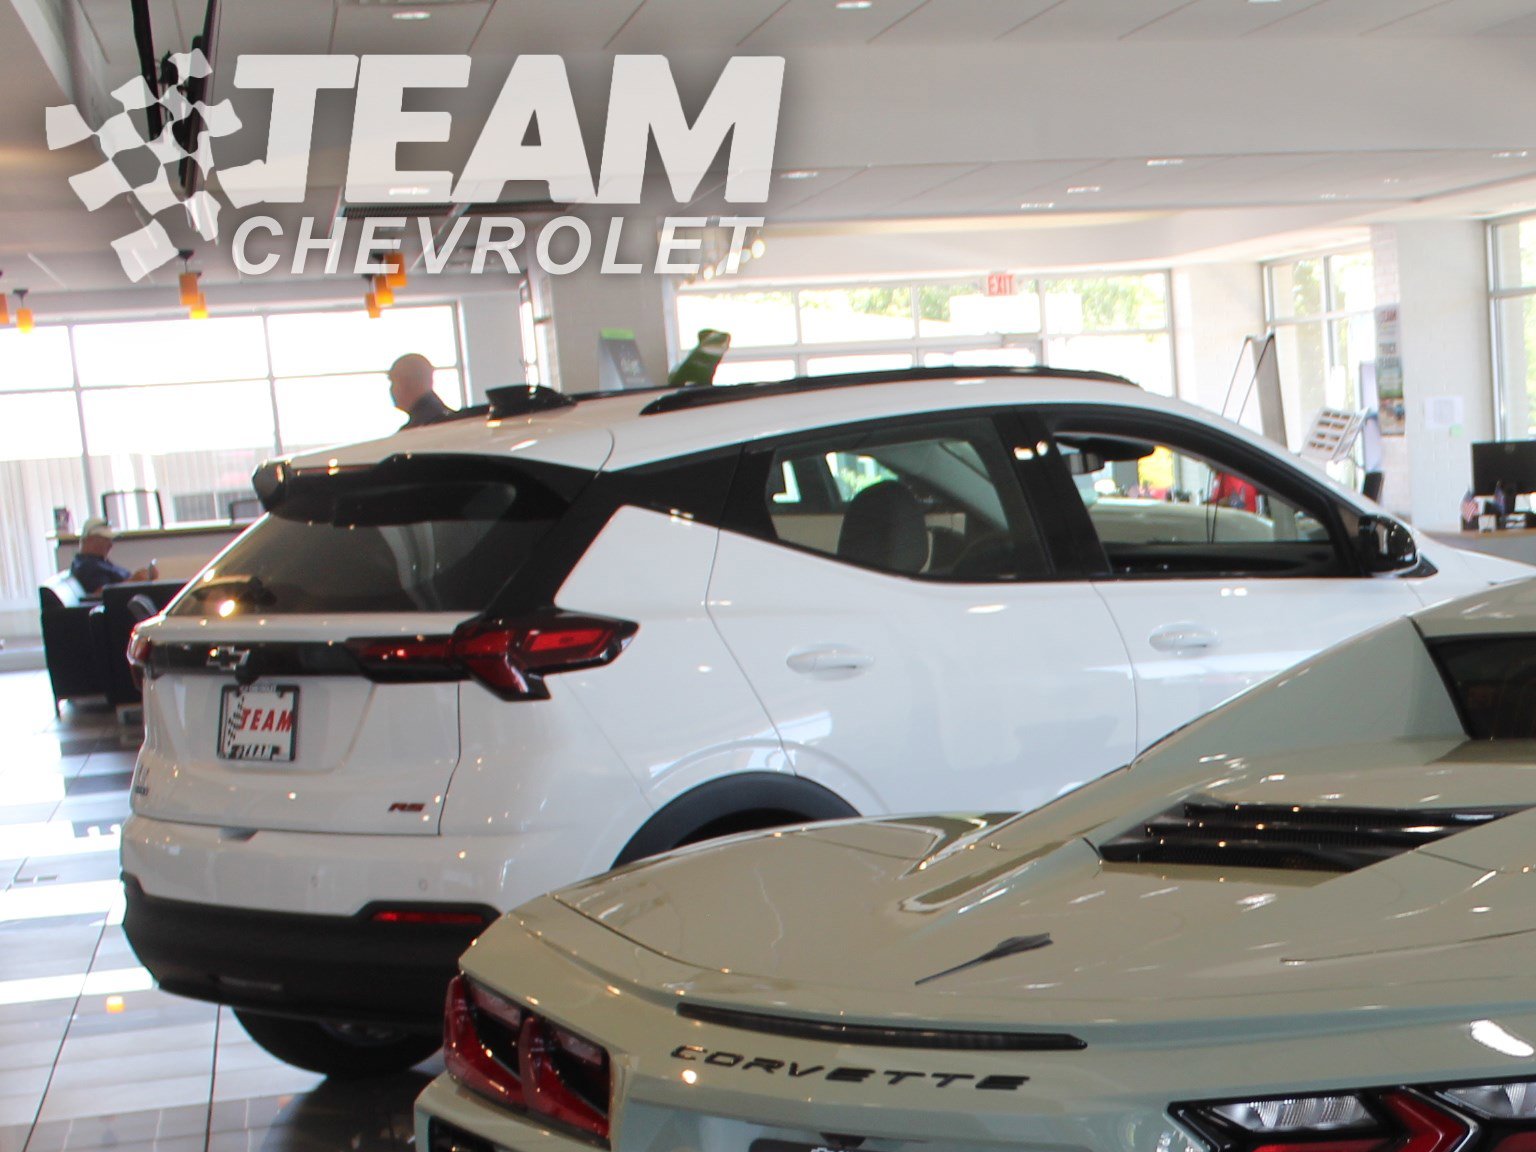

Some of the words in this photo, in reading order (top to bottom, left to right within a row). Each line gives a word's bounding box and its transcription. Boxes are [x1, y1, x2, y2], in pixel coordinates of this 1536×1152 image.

[988, 273, 1014, 296] EXIT
[239, 708, 293, 732] TEAM
[670, 1045, 1030, 1091] CORVETTE
